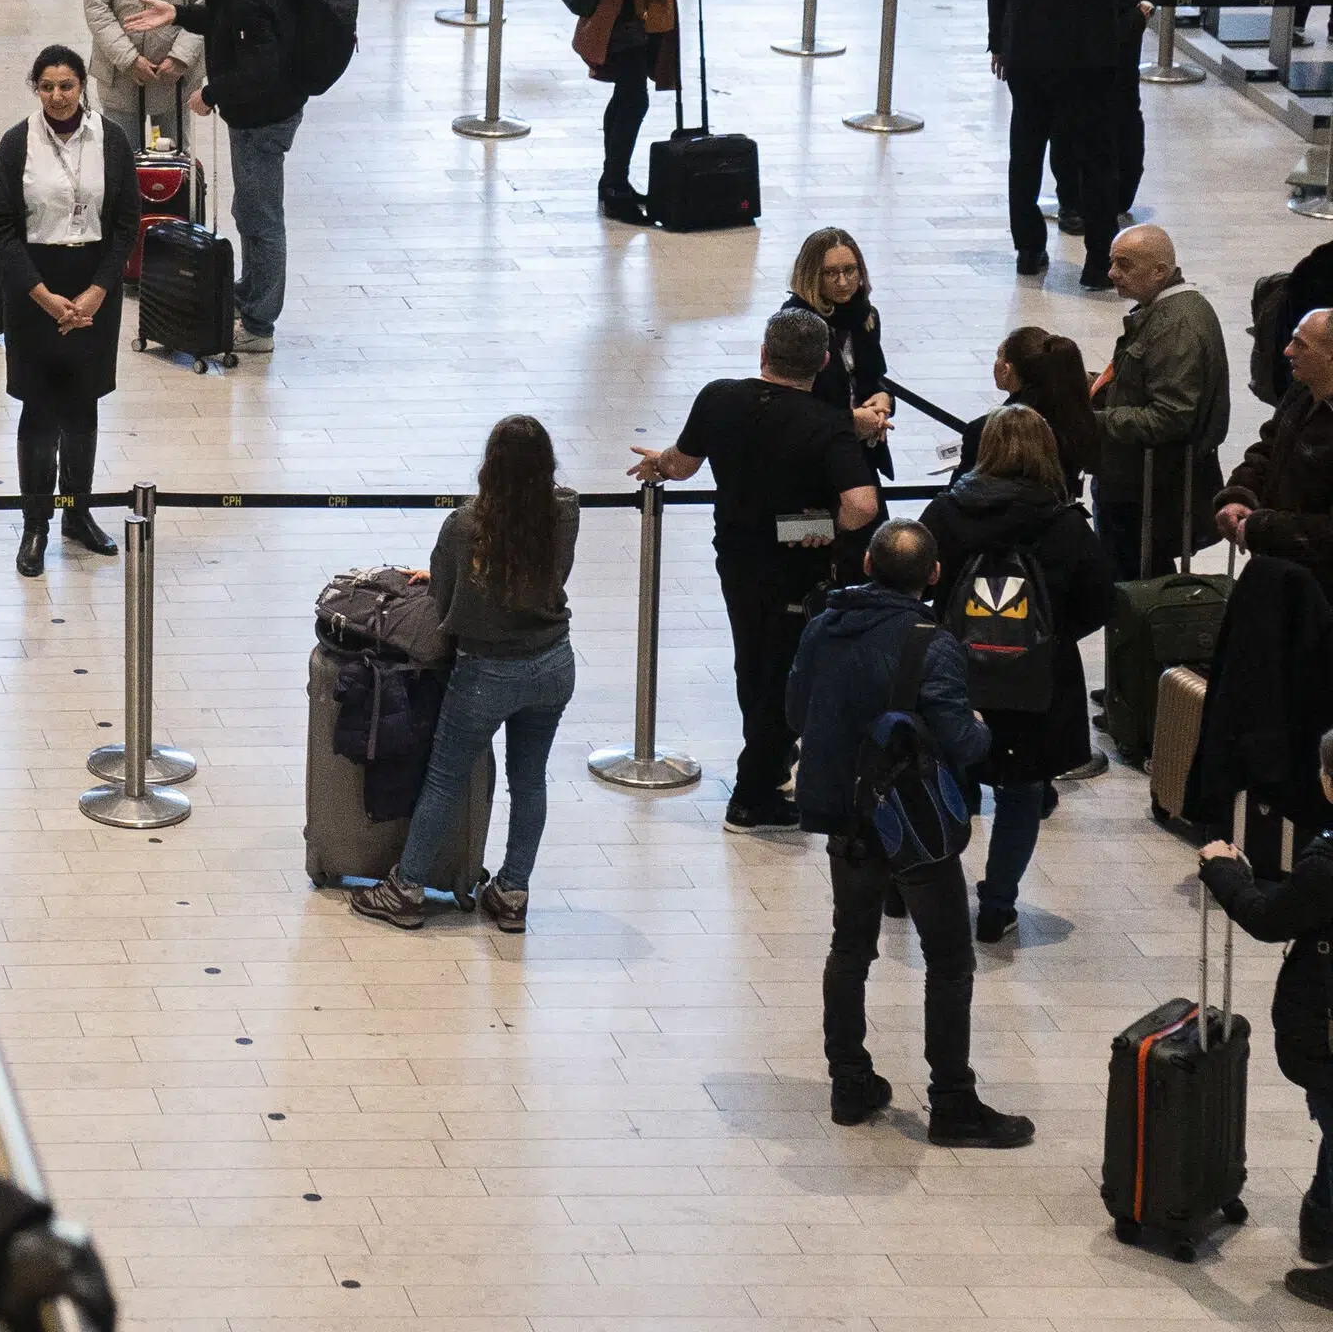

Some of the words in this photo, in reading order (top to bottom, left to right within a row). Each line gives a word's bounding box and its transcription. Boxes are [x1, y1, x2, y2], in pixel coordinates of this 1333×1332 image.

[54, 496, 74, 508] CPH
[222, 496, 242, 506] CPH
[328, 496, 348, 507] CPH
[434, 496, 454, 507] CPH
